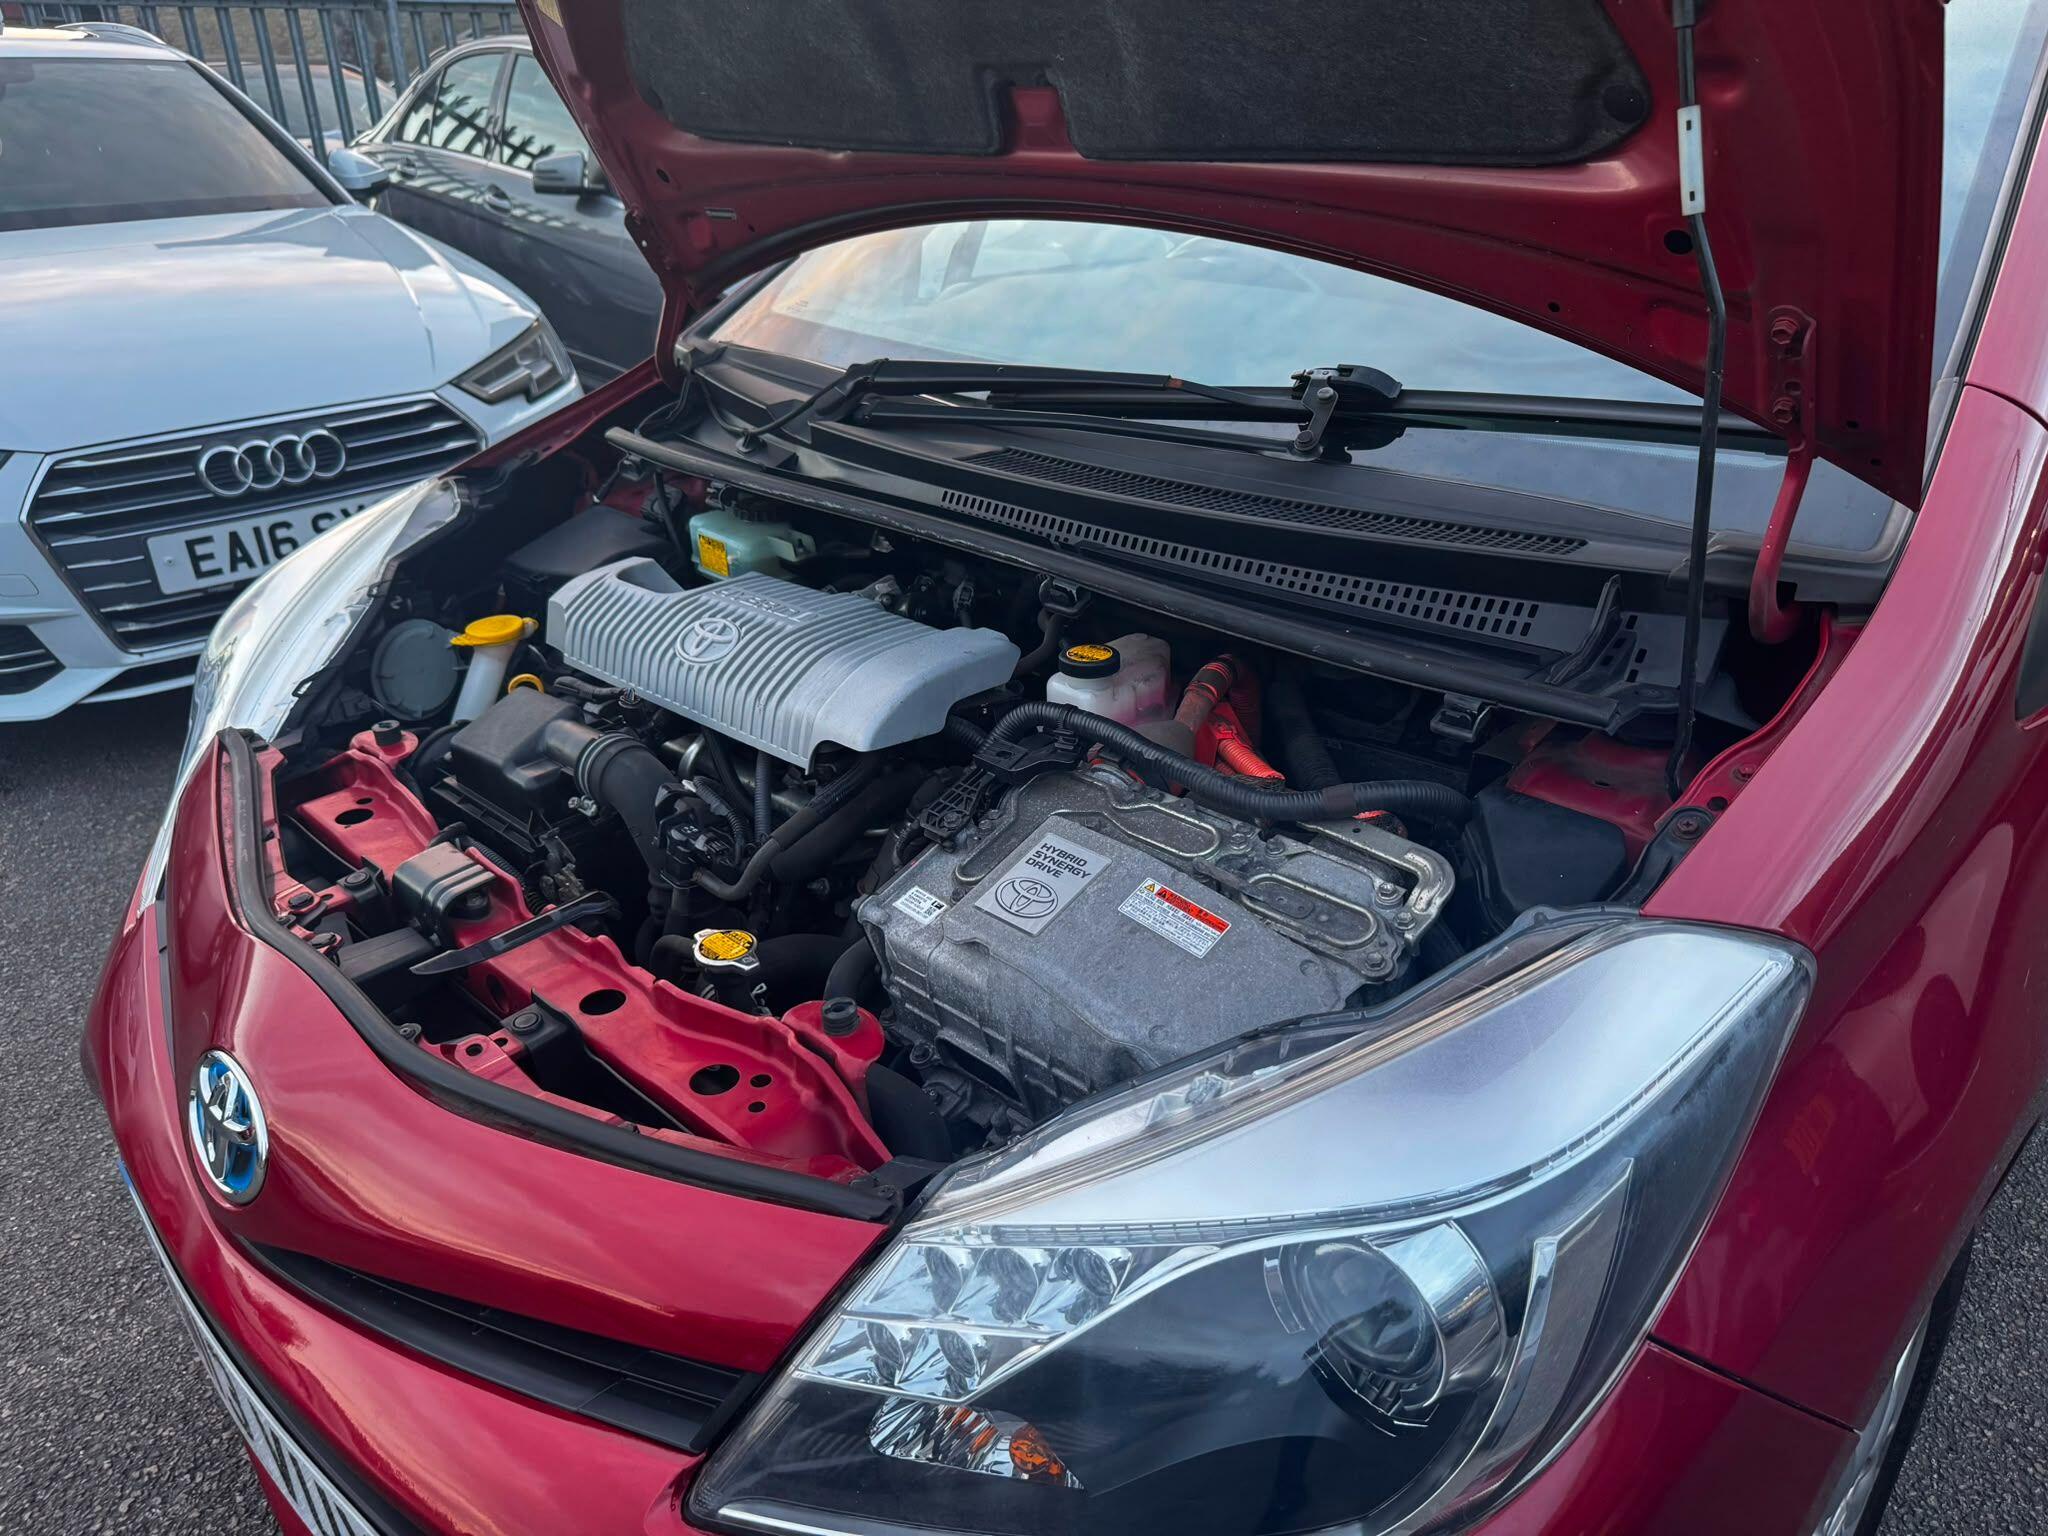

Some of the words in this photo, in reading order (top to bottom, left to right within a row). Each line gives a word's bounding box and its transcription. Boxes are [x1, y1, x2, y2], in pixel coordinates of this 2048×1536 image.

[185, 521, 299, 579] EA16
[1025, 858, 1063, 878] DRIVE
[1033, 850, 1091, 878] SYNERGY
[1040, 843, 1087, 867] HYBRID
